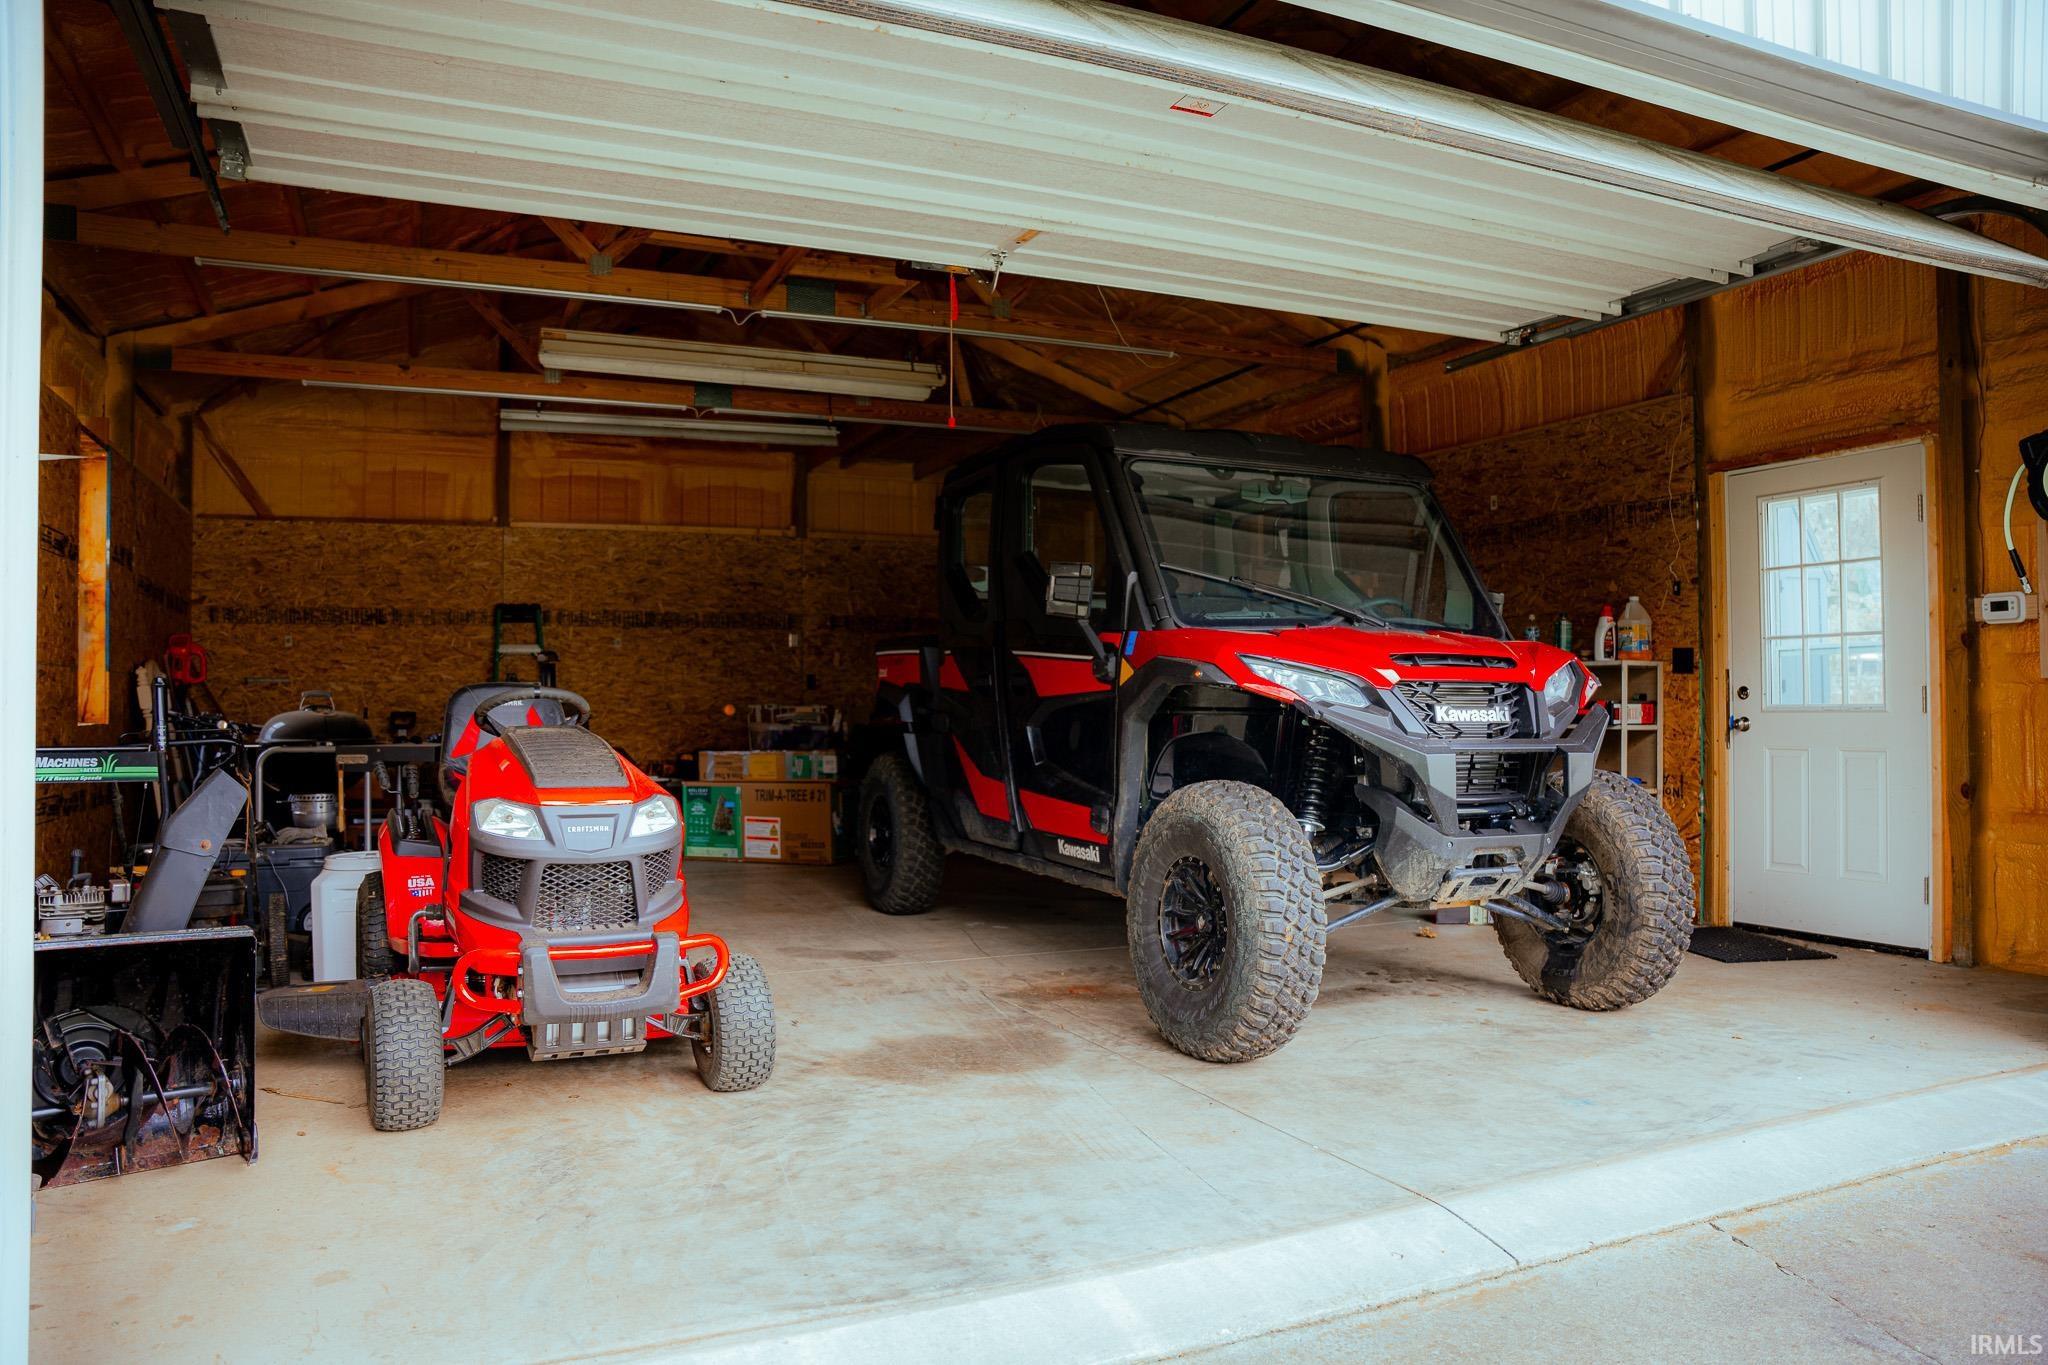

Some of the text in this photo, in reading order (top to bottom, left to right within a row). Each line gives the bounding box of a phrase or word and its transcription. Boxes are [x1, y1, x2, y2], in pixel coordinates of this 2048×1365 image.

[1436, 705, 1510, 722] Kawasaki
[36, 757, 98, 768] MACHINES
[755, 788, 808, 801] TRIM-A-TREE
[567, 825, 610, 833] CRAFTSMAN
[1057, 838, 1100, 863] Kawasaki
[408, 877, 435, 888] USA
